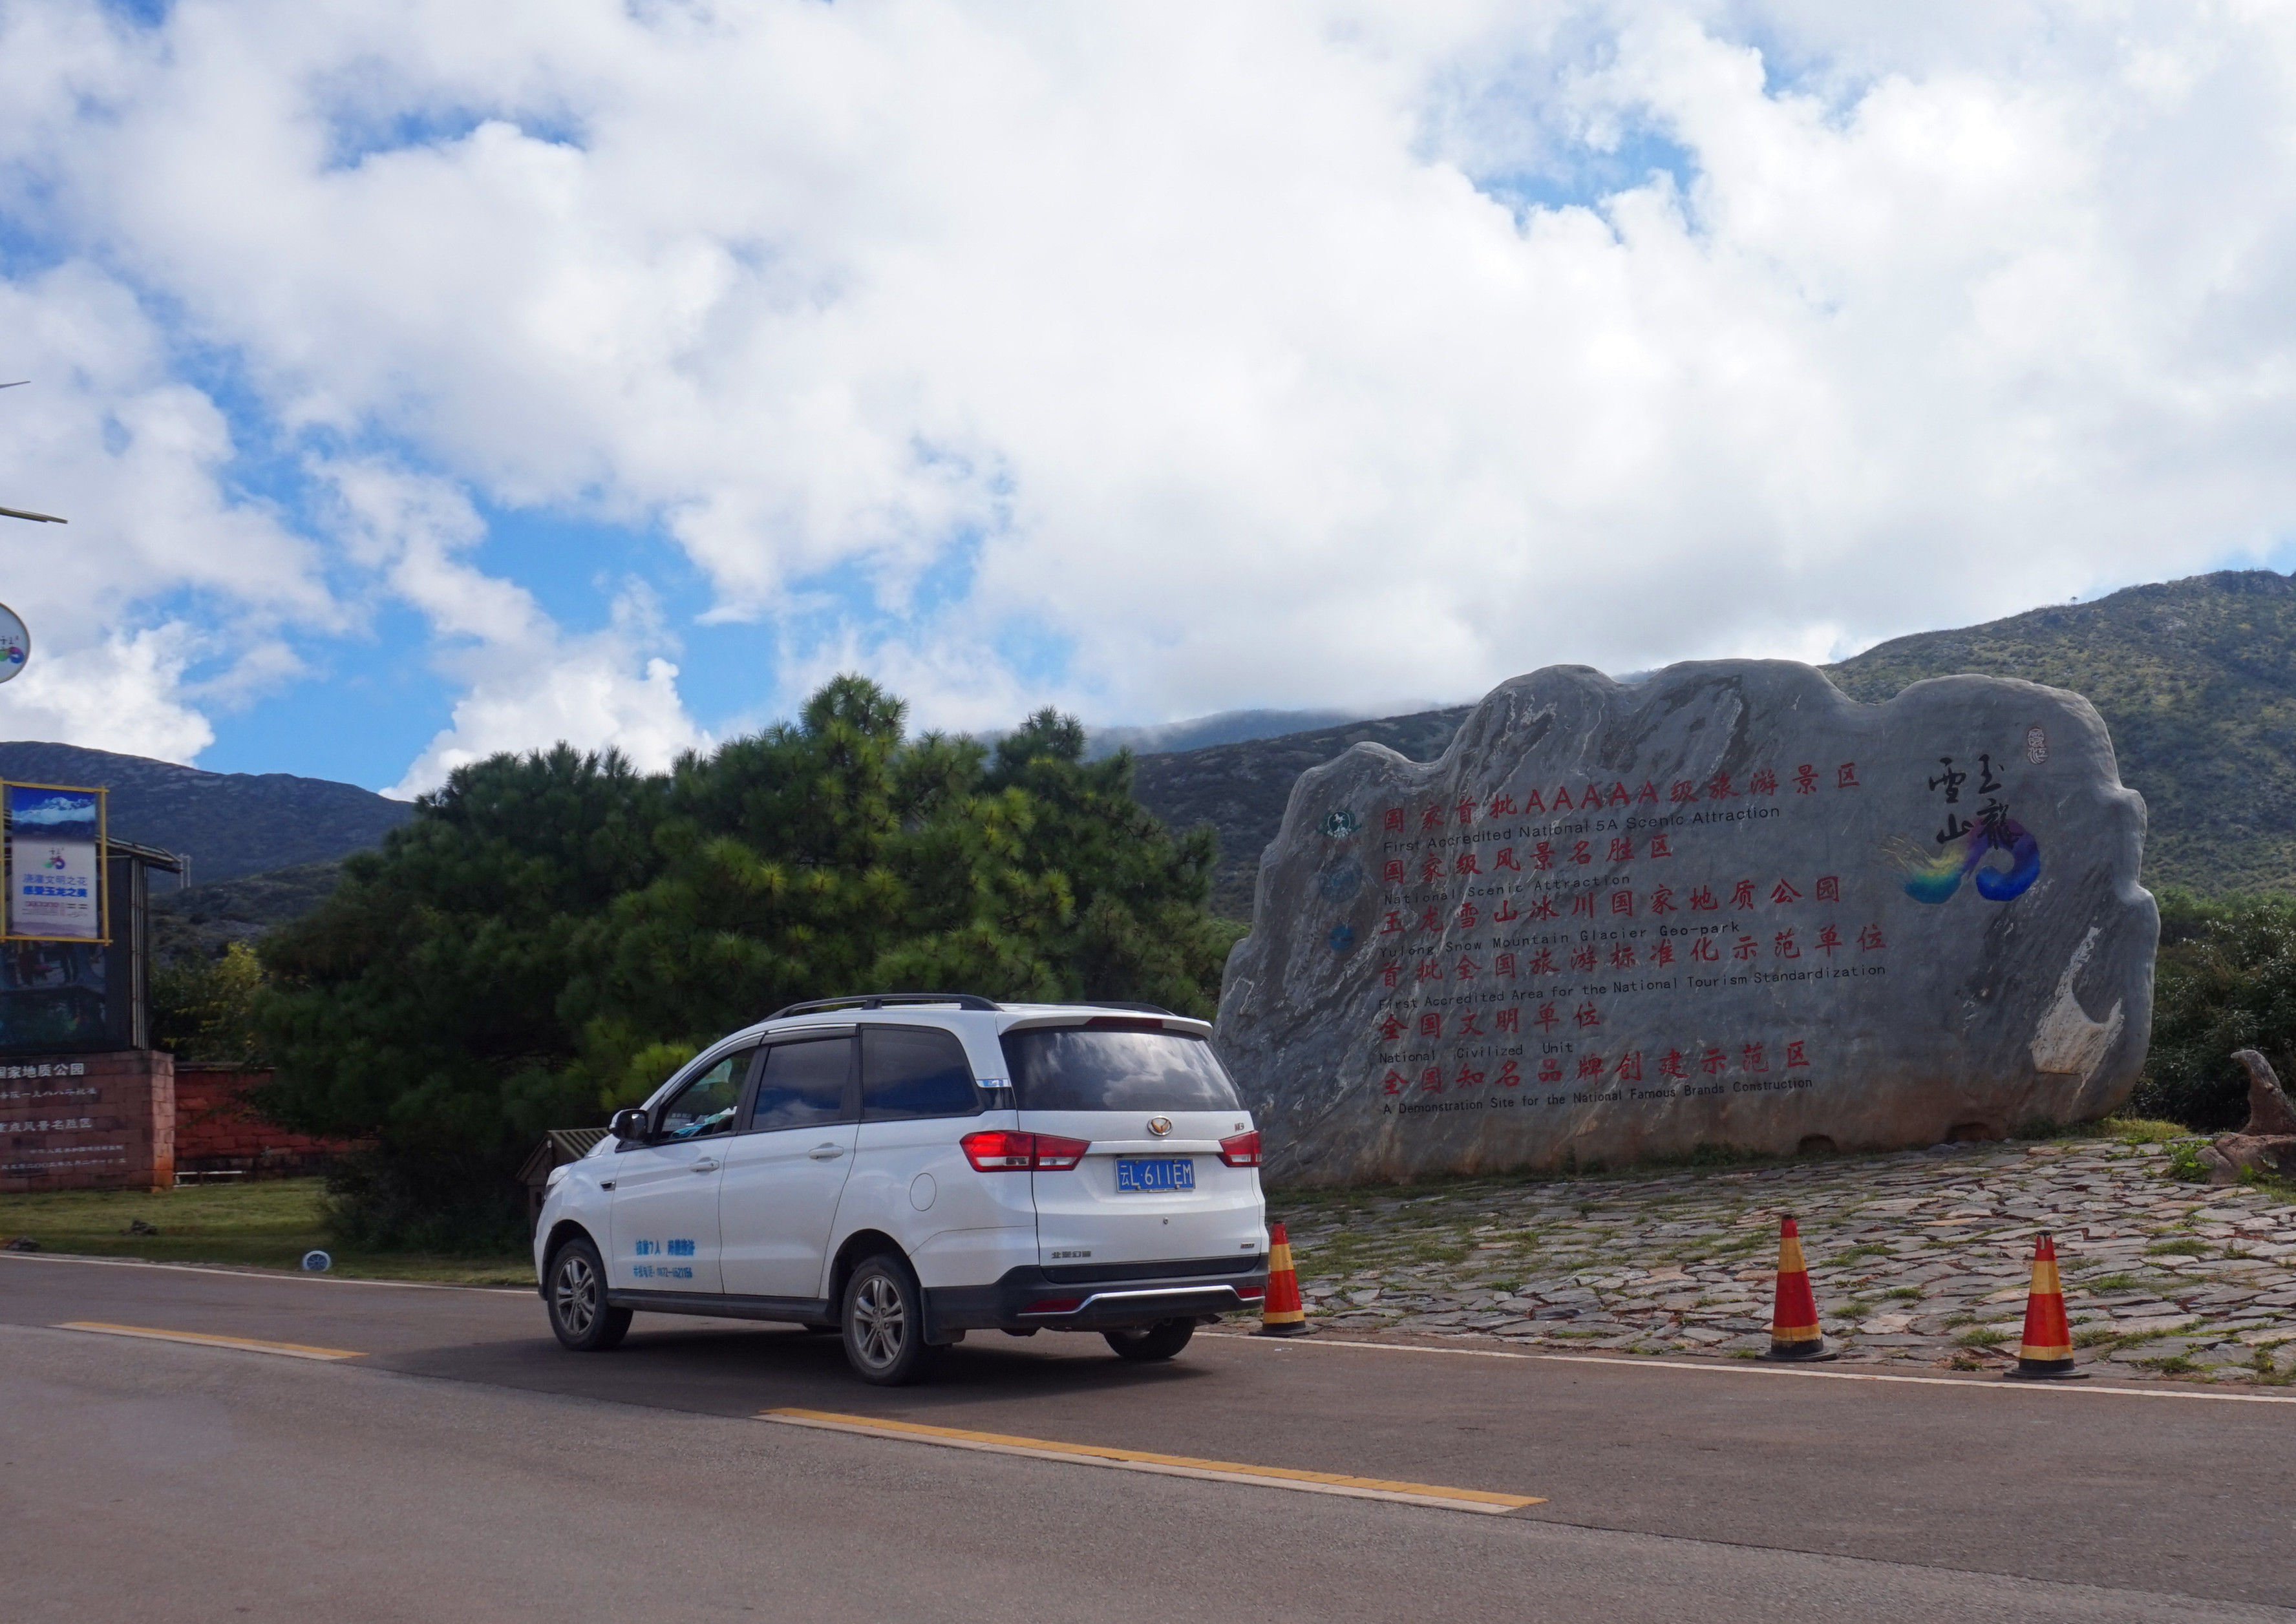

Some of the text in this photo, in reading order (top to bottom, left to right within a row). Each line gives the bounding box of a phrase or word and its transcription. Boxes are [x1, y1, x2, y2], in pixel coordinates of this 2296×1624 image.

[1384, 763, 1860, 833] 国家首批AAAAA级旅游景区
[1384, 806, 1780, 854] First Accredited National 5A Scenic Attraction
[1384, 834, 1673, 884] 国家级风景名胜区
[1380, 876, 1839, 935] 玉龙雪山冰川国家地质公园
[1385, 875, 1630, 905] National Scenic Attraction
[1379, 923, 1886, 988] 首批全国旅游标准化示范单位
[1381, 922, 1740, 958] Yulong Snow Mountain Glacier Geo-park
[1379, 965, 1886, 1010] First Accredited Area for the National Tourism Standardization
[1379, 1001, 1601, 1040] 全国文明单位
[1379, 1042, 1573, 1064] National Civilized Unit
[1380, 1040, 1811, 1096] 全国知名品牌创建示范区
[1383, 1078, 1812, 1115] A Demonstration Site for the National Famous Brands Construction
